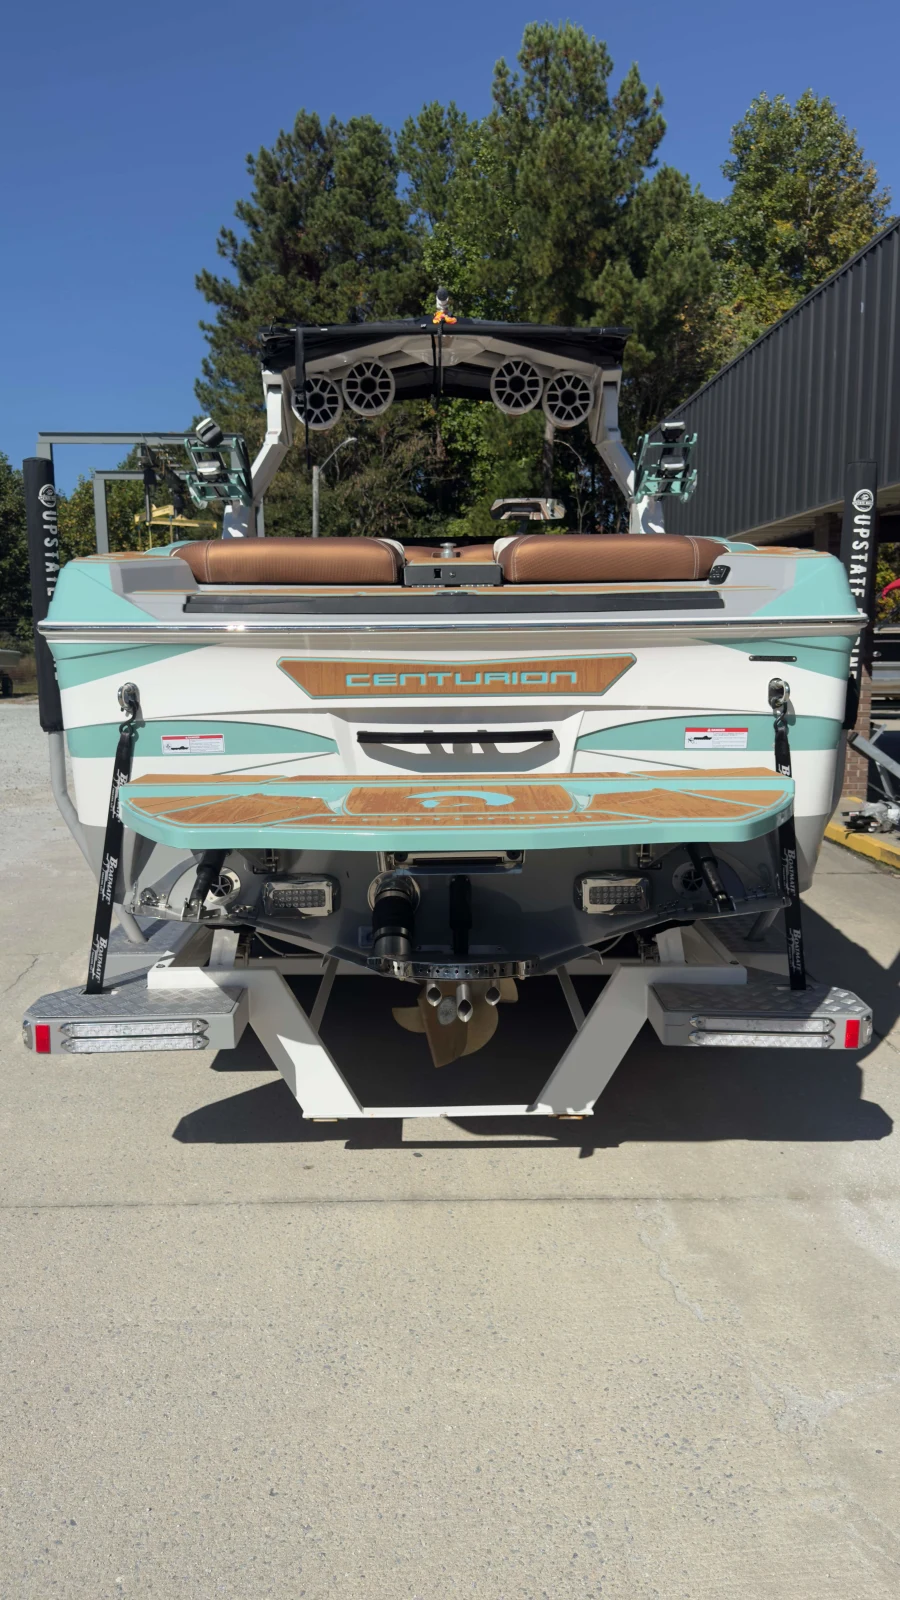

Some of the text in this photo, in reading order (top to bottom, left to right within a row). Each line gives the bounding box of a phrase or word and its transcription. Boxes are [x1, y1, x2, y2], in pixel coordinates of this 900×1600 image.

[849, 514, 871, 597] UPSTATE
[346, 671, 578, 687] CENTURION
[105, 856, 118, 902] BOATMATE
[787, 849, 796, 893] BOATMATE
[95, 936, 108, 981] BOATMATE
